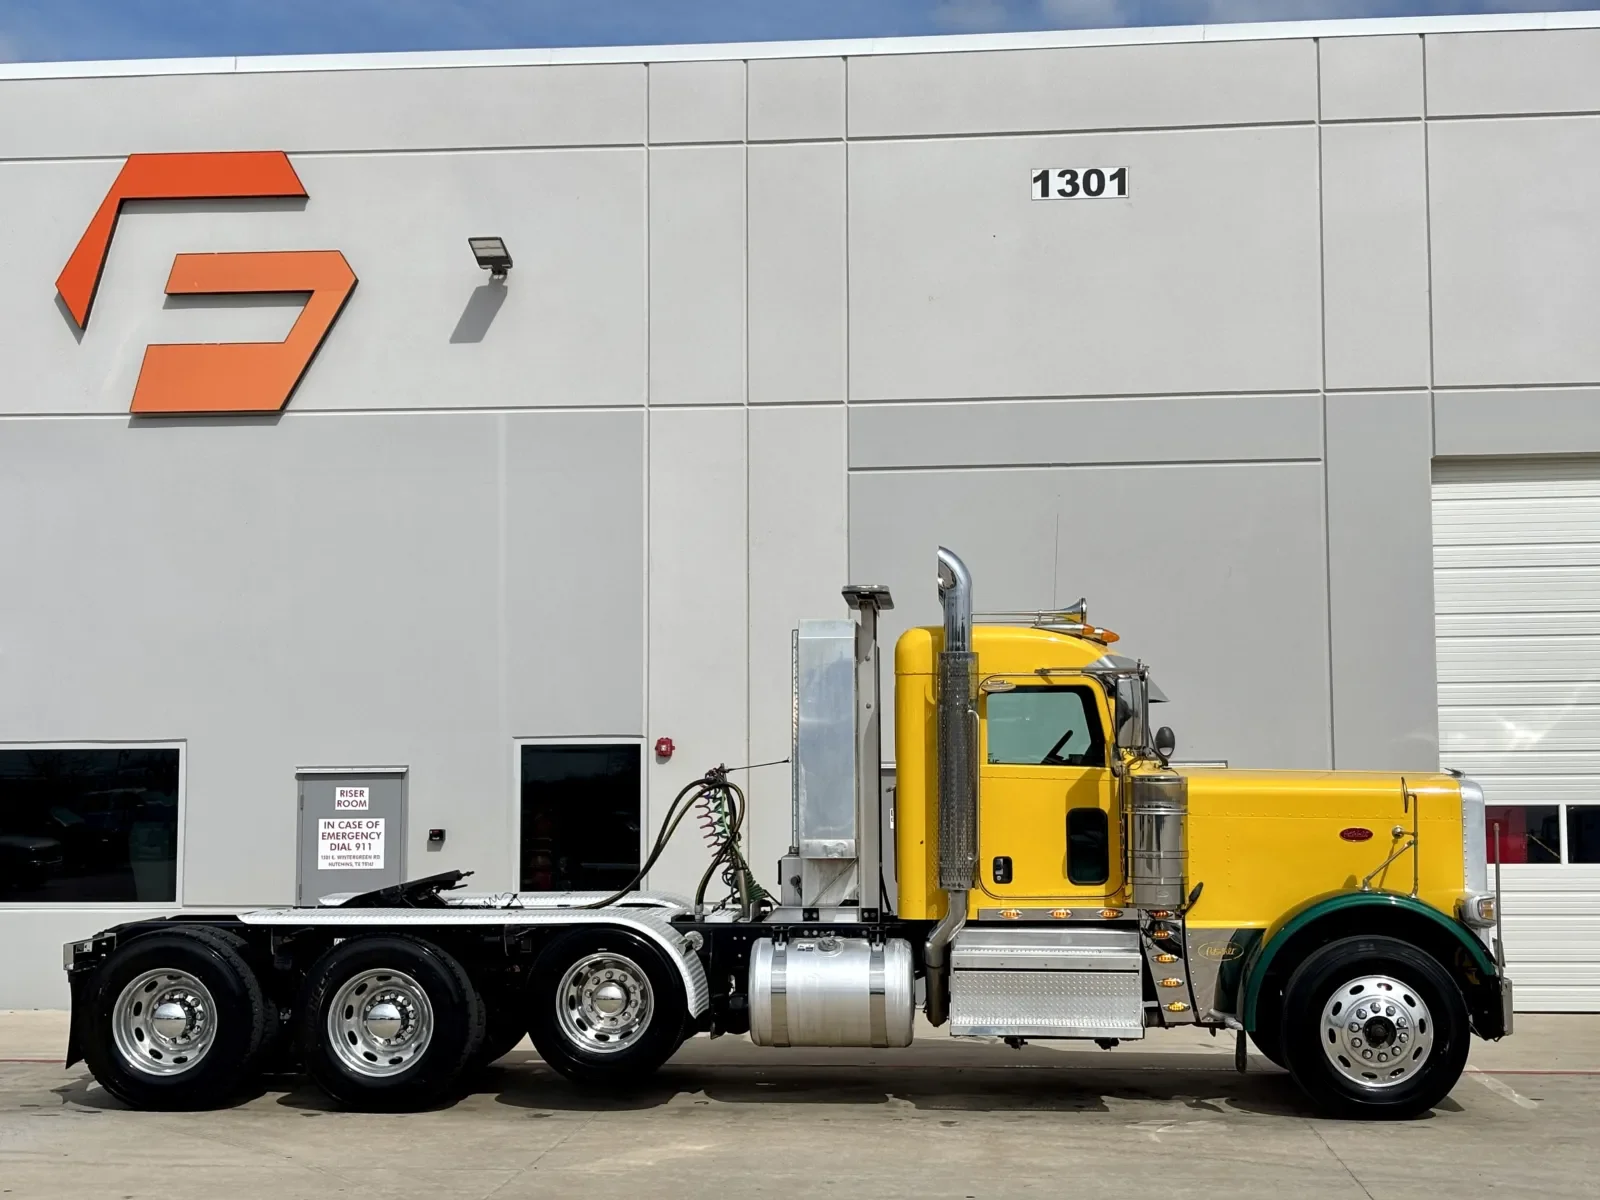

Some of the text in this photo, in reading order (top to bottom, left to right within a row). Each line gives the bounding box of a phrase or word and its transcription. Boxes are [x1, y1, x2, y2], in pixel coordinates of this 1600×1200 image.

[1033, 167, 1126, 198] 1301
[340, 789, 365, 798] RISER
[337, 799, 367, 808] ROOM
[324, 820, 380, 829] IN CASE OF
[321, 831, 382, 840] EMERGENCY
[330, 842, 372, 851] DIAL 911
